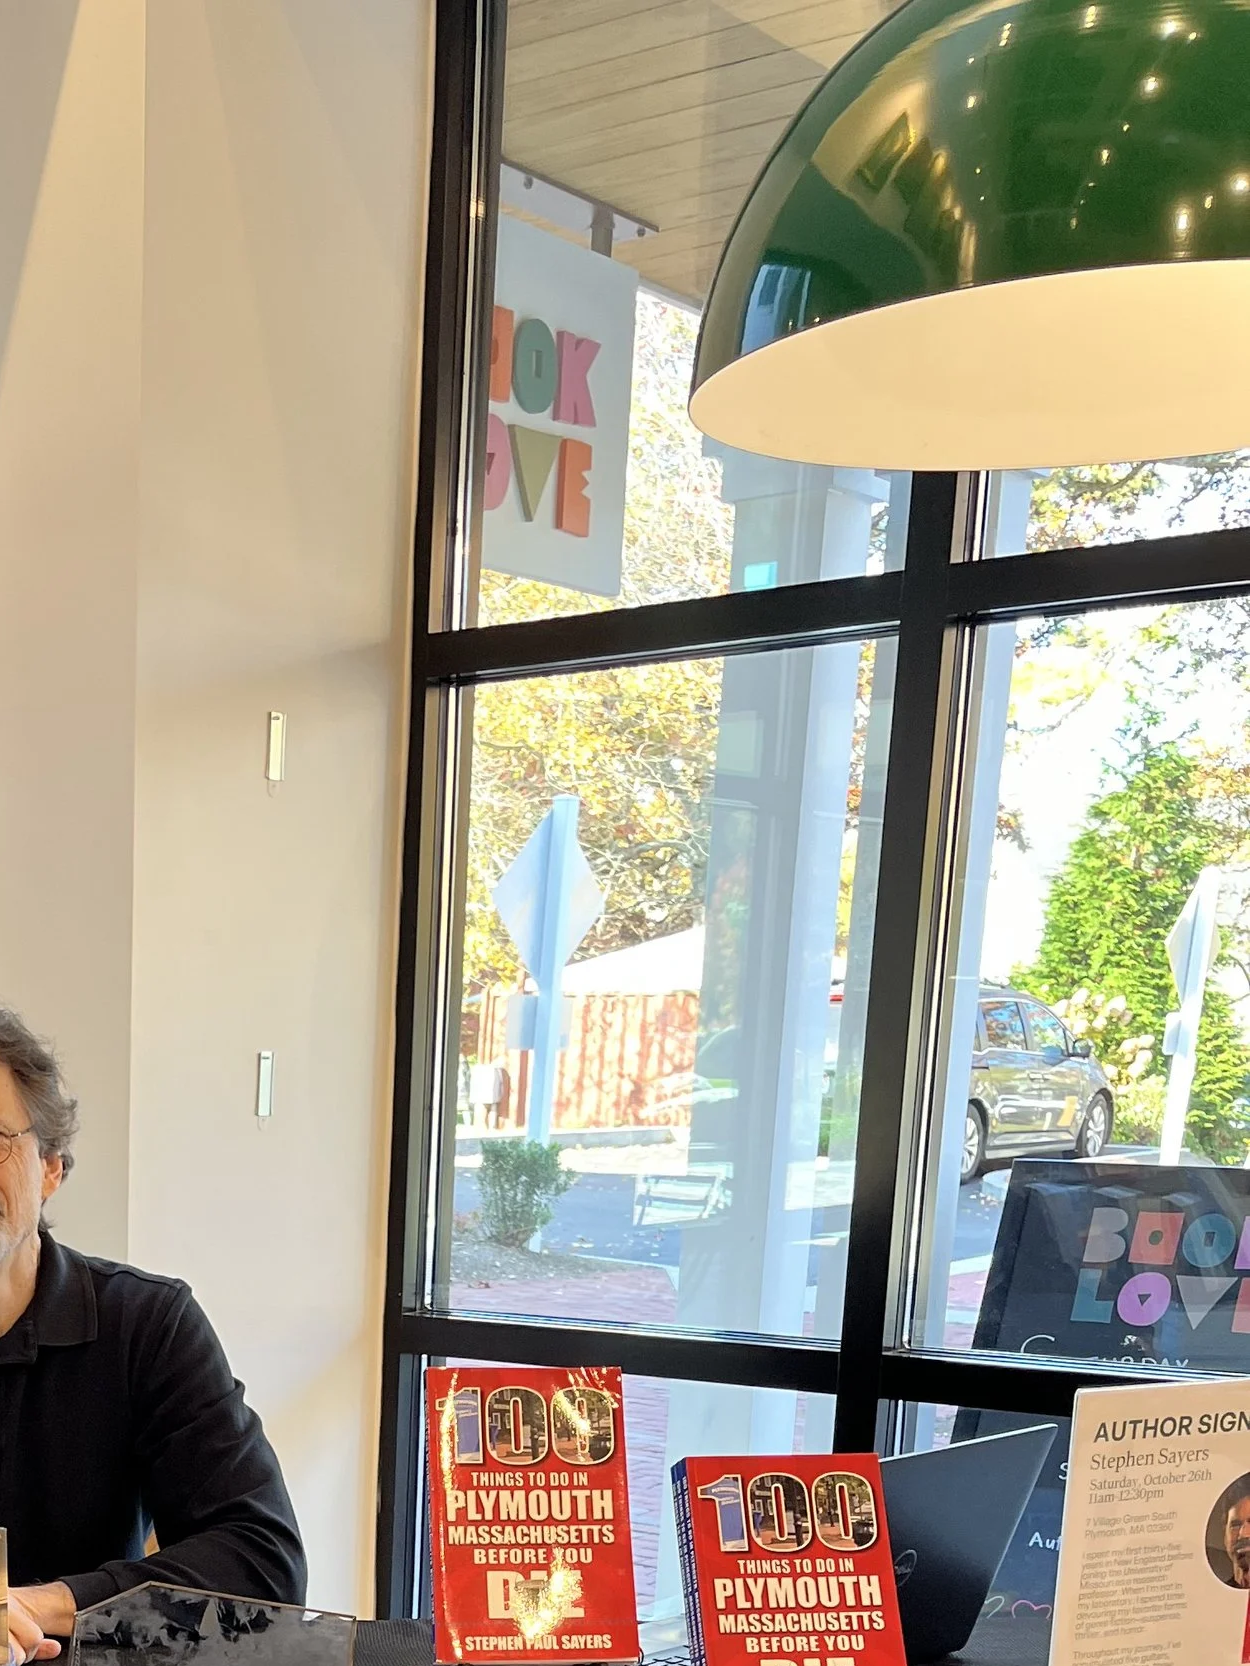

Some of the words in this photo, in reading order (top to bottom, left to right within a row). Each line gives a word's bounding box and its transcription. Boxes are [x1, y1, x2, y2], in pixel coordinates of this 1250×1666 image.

[436, 1386, 614, 1465] 100
[1094, 1416, 1192, 1443] AUTHOR
[1090, 1450, 1154, 1472] Stephen
[1158, 1448, 1209, 1468] Sayers
[471, 1472, 524, 1487] THINGS
[528, 1472, 546, 1486] TO
[550, 1472, 569, 1486] DO
[573, 1472, 588, 1486] IN
[1090, 1476, 1142, 1491] Saturday,
[1144, 1472, 1186, 1486] October
[1188, 1469, 1212, 1482] 26th
[446, 1489, 614, 1522] PLYMOUTH
[697, 1471, 878, 1552] 100
[448, 1524, 615, 1545] MASSACHUSETTS
[474, 1548, 547, 1564] BEFORE
[552, 1547, 593, 1564] YOU
[737, 1559, 791, 1574] THINGS
[794, 1559, 812, 1573] TO
[816, 1558, 835, 1573] DO
[839, 1558, 855, 1572] IN
[713, 1575, 883, 1610] PLYMOUTH
[718, 1611, 885, 1634] MASSACHUSETTS
[465, 1636, 522, 1651] STEPHEN
[526, 1635, 559, 1650] PAUL
[562, 1634, 612, 1649] SAYERS
[746, 1636, 820, 1653] BEFORE
[824, 1635, 865, 1651] YOU
